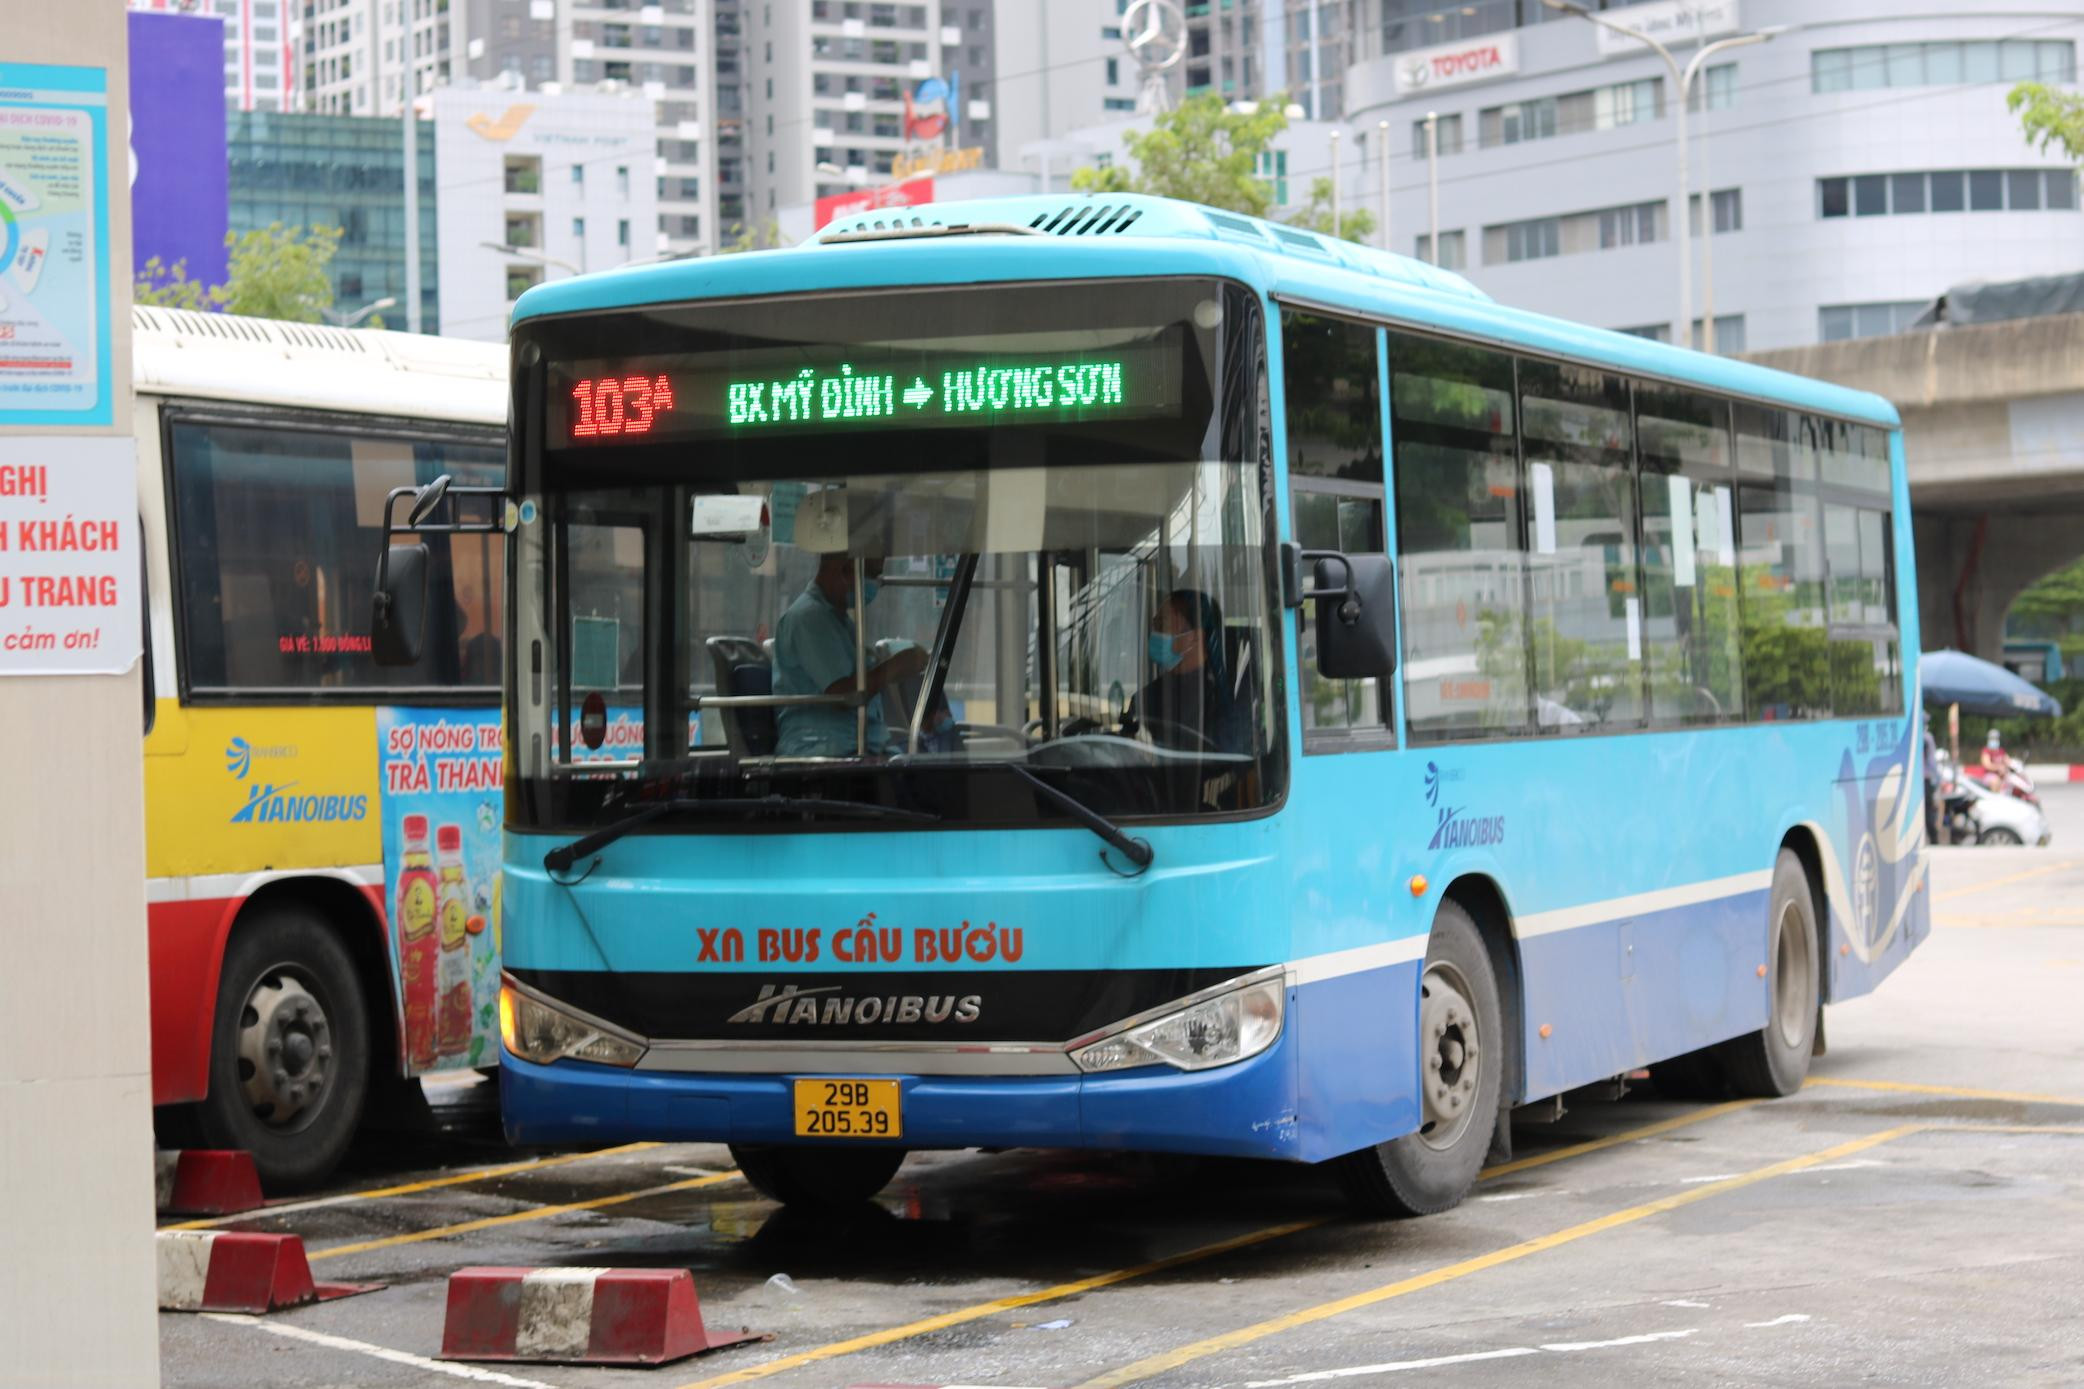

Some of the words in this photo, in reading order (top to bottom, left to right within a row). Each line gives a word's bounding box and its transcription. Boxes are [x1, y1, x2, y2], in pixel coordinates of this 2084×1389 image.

[1431, 47, 1502, 78] TOYOTA
[730, 383, 768, 424] BX
[772, 369, 815, 421] MỸ
[944, 367, 1054, 412] HƯƠNG
[1058, 363, 1122, 405] SƠN
[19, 514, 119, 552] KHÁCH
[20, 575, 118, 607] TRANG
[4, 625, 56, 651] cảm
[63, 628, 100, 650] ơn!
[390, 724, 415, 755] SỢ
[419, 721, 474, 750] NÓNG
[387, 753, 429, 792] TRÀ
[229, 780, 368, 823] HANOIBUS
[1427, 806, 1505, 850] HANOIBUS
[758, 928, 821, 963] BUS
[832, 912, 903, 963] CẦU
[726, 984, 983, 1025] HANOIBUS
[824, 1083, 869, 1107] 29B
[806, 1111, 889, 1134] 205.39
